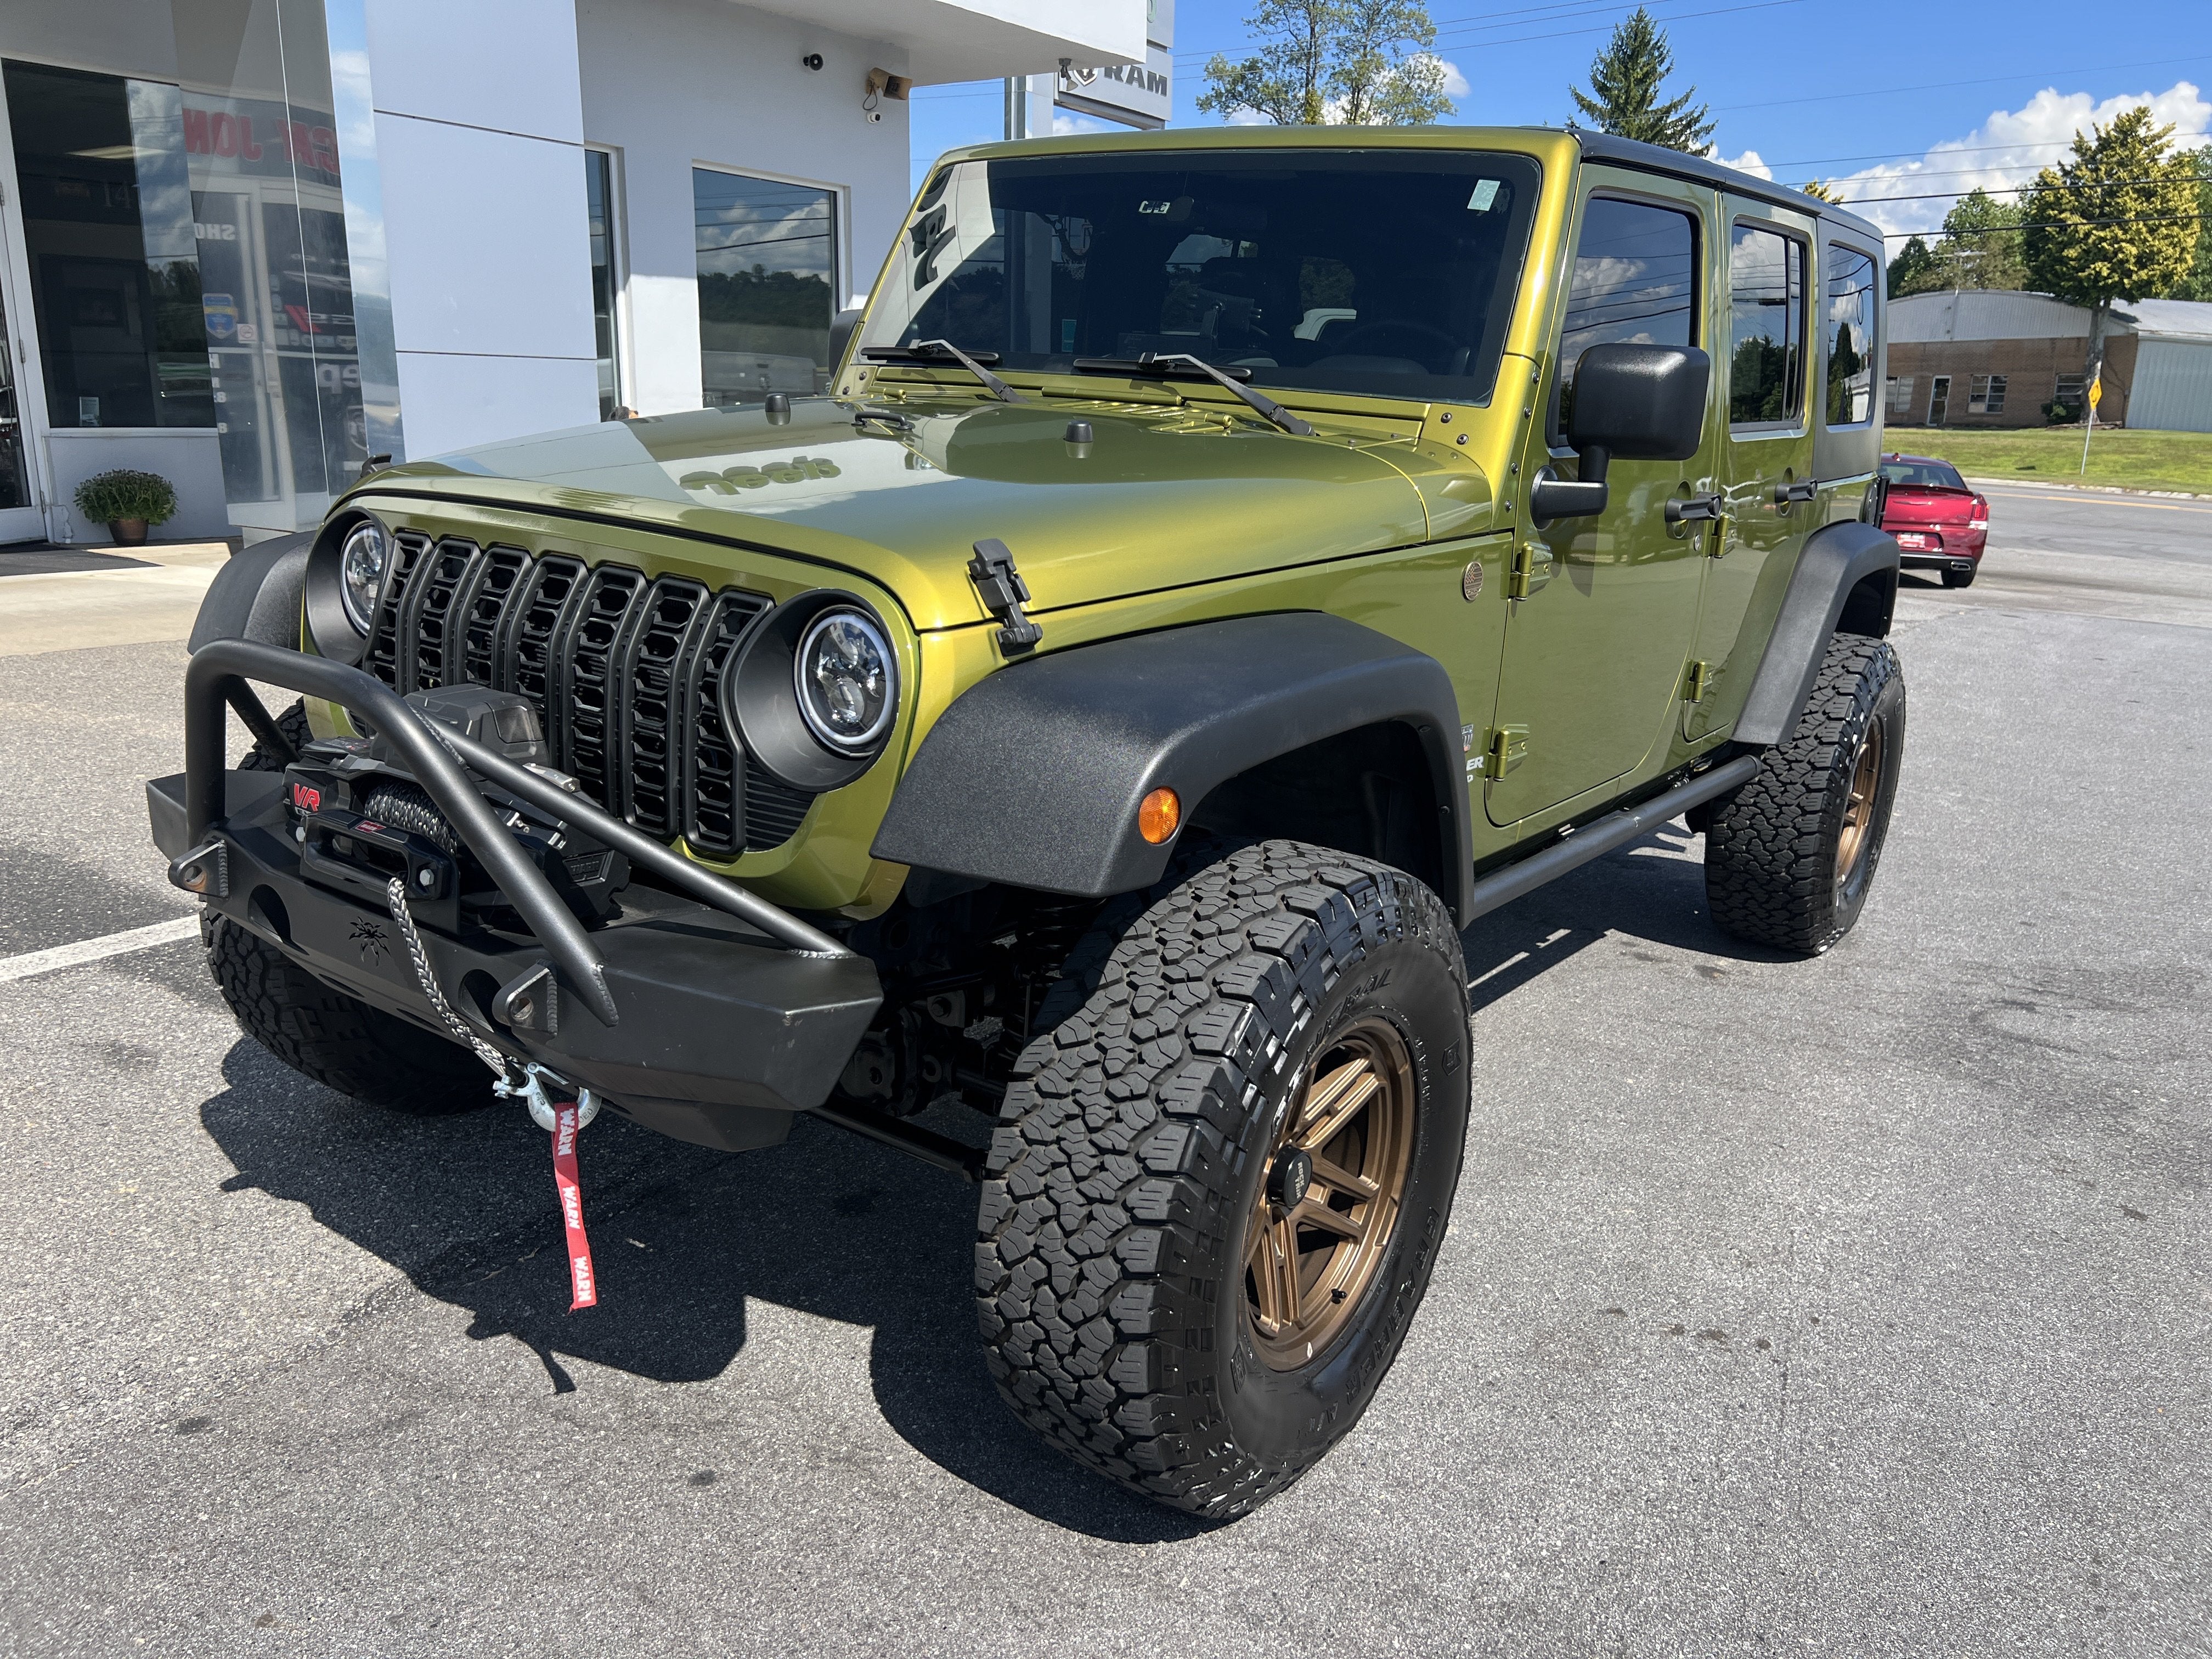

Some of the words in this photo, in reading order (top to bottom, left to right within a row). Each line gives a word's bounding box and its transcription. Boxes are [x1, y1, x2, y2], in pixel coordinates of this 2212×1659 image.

[1104, 65, 1167, 97] RAM
[294, 782, 320, 812] VR
[558, 1108, 575, 1156] WARN
[562, 1185, 580, 1230] WARN
[573, 1256, 592, 1302] WARN
